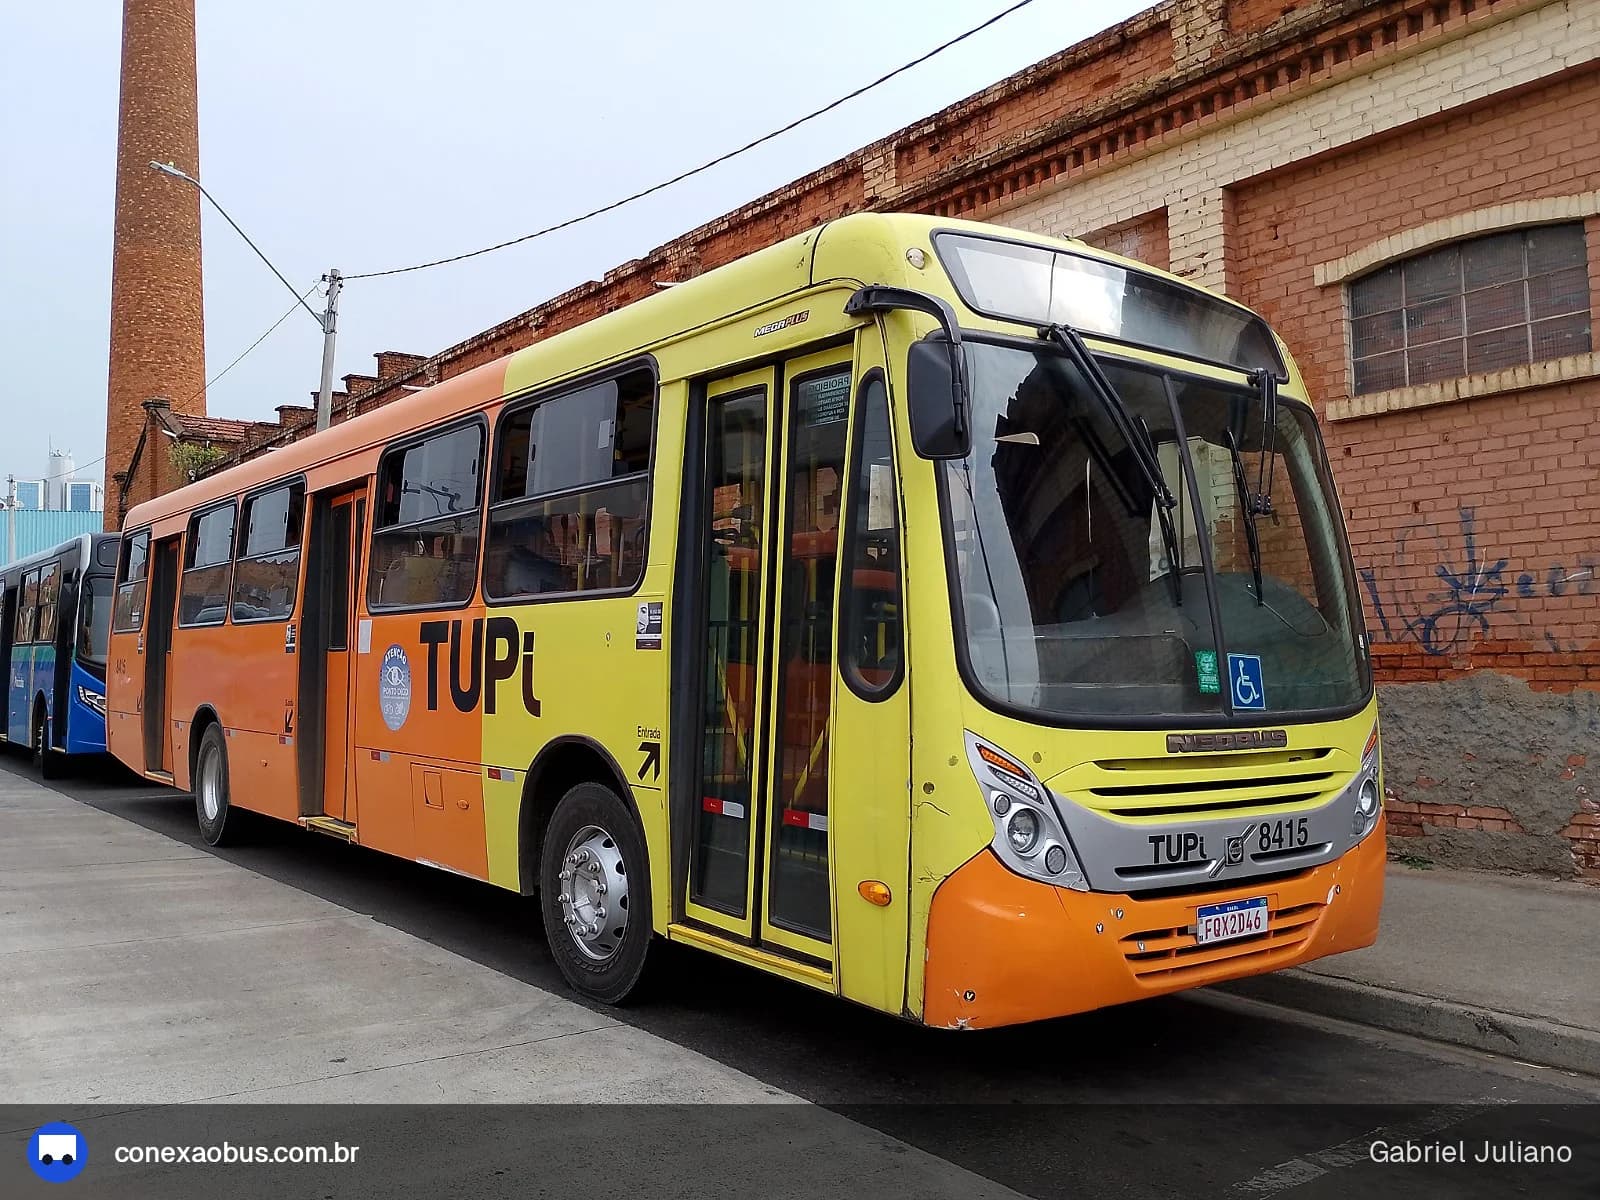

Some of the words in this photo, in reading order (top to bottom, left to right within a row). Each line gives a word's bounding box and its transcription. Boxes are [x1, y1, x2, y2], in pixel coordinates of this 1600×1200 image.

[384, 647, 407, 665] ATENÇÃO
[637, 725, 661, 739] Entrada
[1167, 730, 1287, 753] NEOBUS
[1258, 818, 1309, 852] 8415
[1205, 910, 1261, 940] FQX2D46
